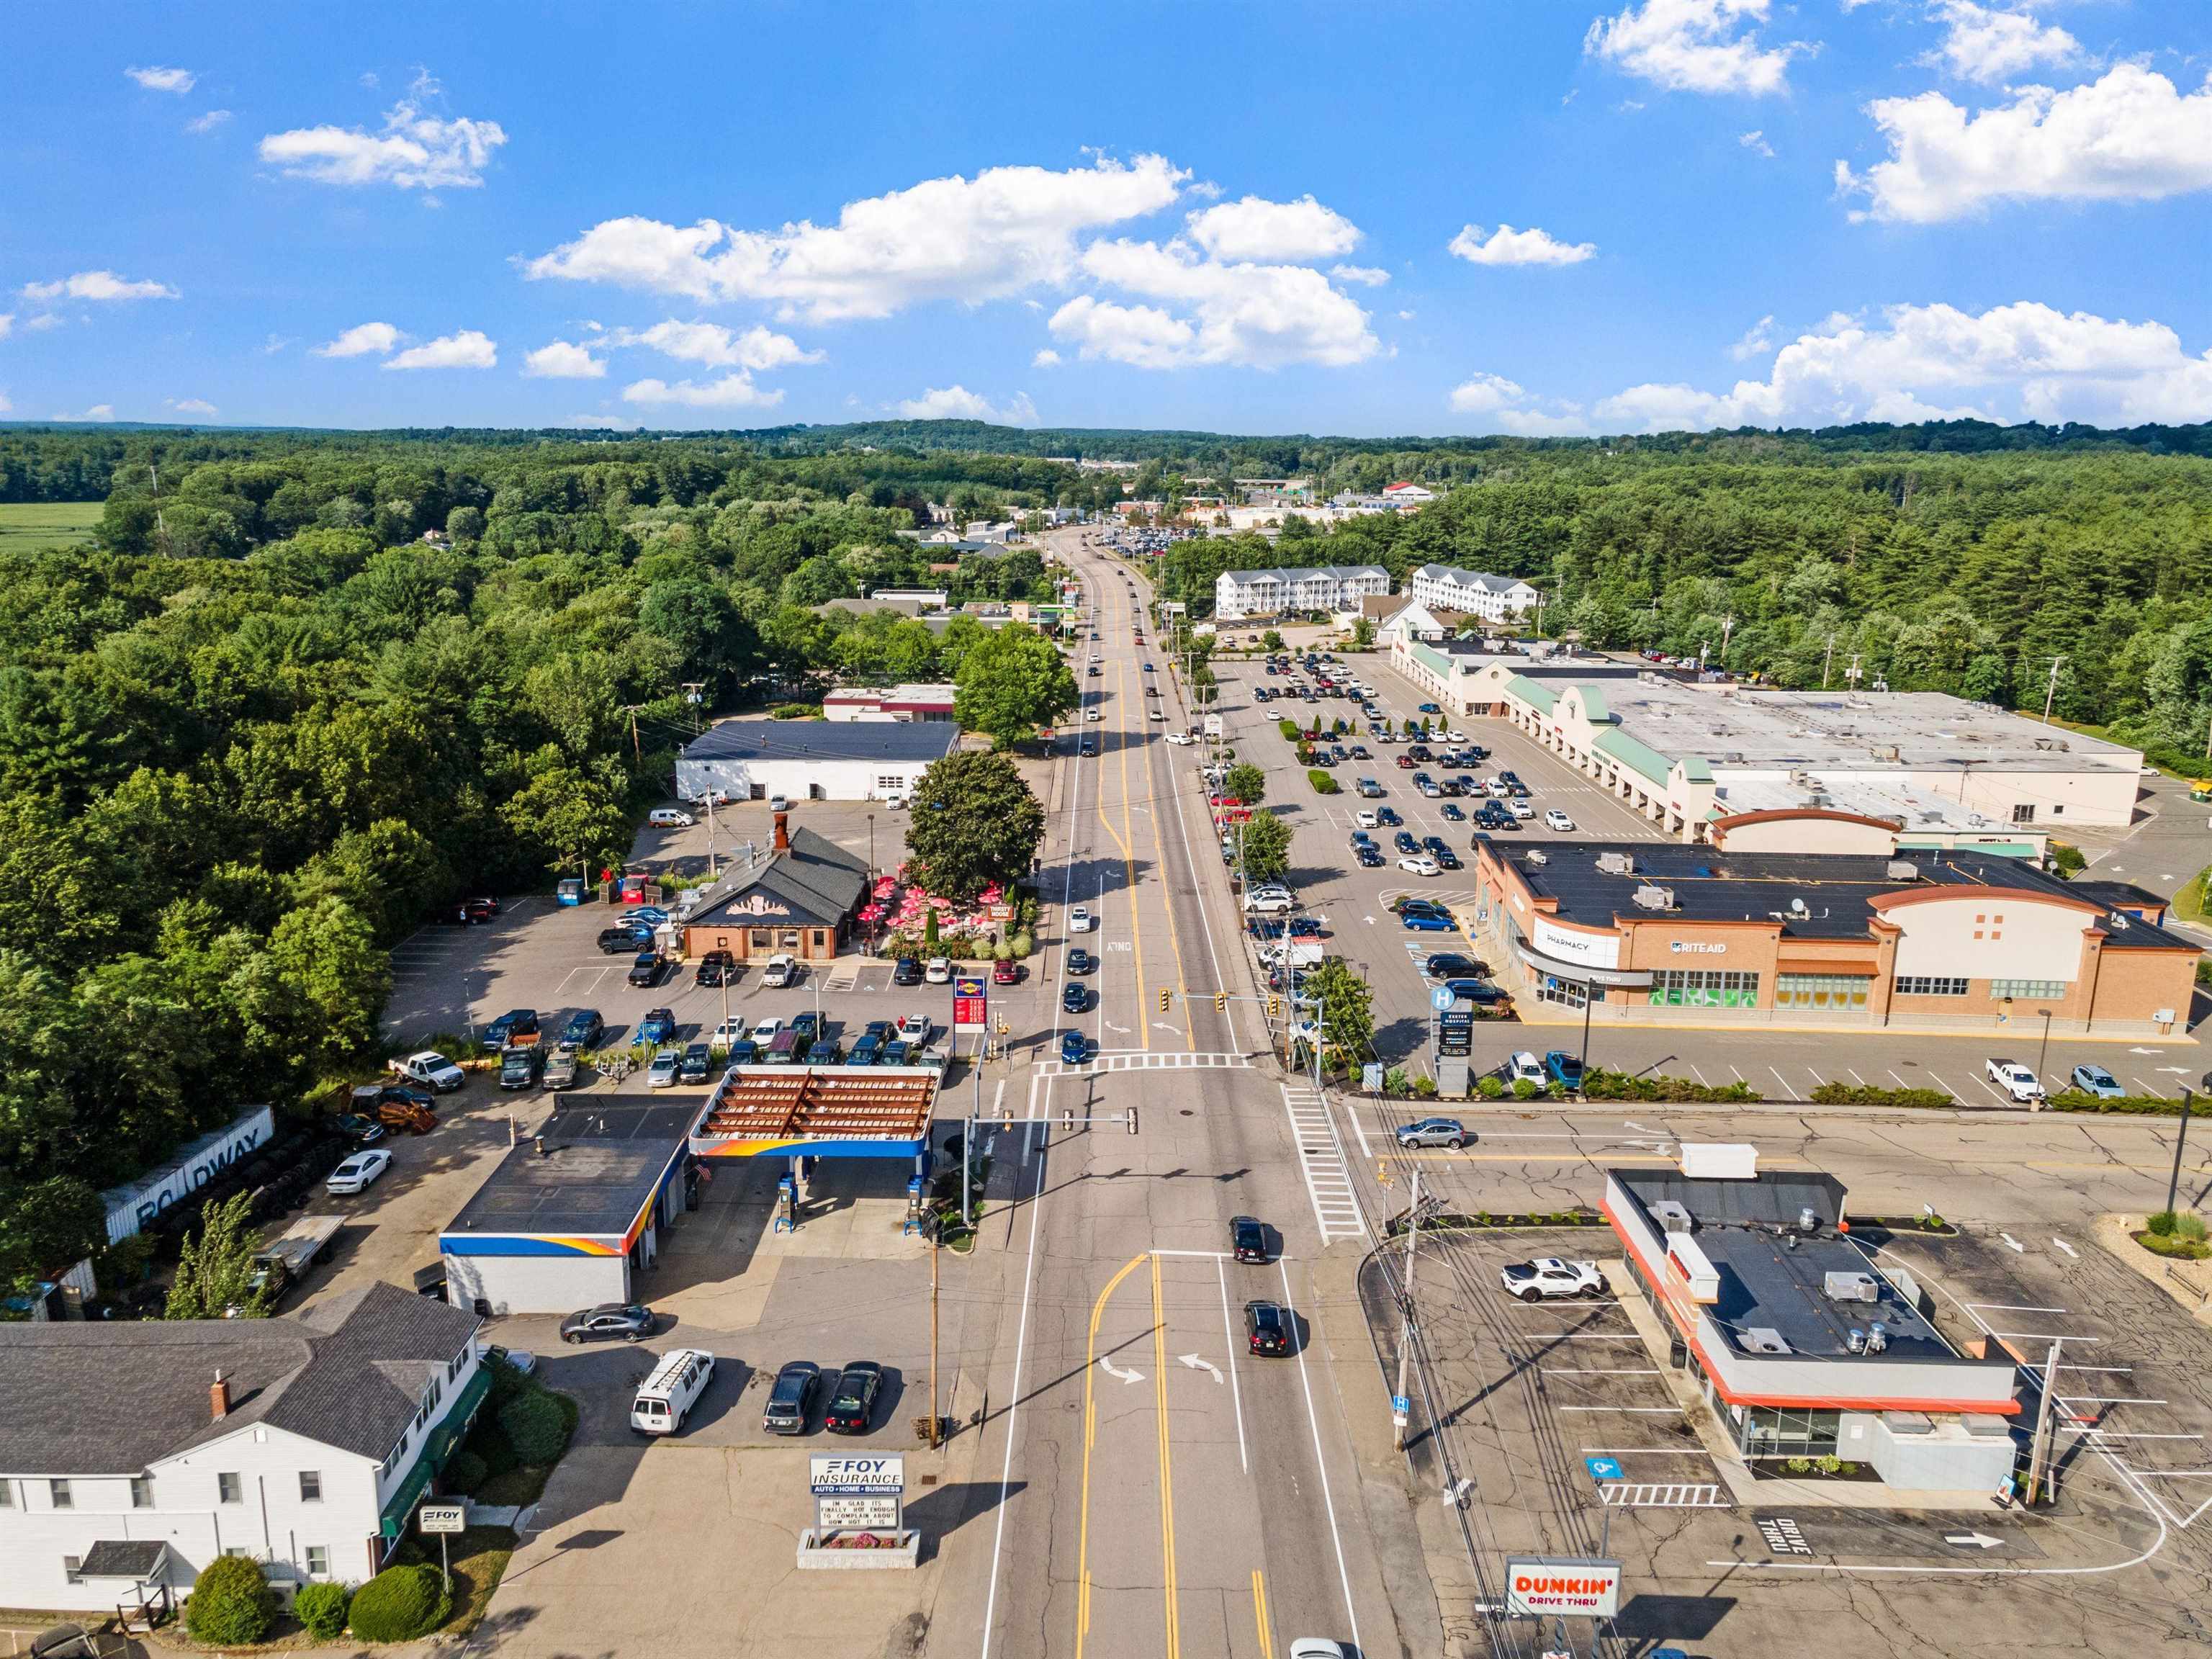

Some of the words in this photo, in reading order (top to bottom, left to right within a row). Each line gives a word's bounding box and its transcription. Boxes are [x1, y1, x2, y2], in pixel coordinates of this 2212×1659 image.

[1107, 941, 1132, 951] ONLY
[1547, 934, 1589, 950] PHARMACY
[1681, 943, 1707, 953] RITE
[1707, 944, 1727, 953] AID
[1436, 991, 1450, 1007] H
[1397, 1397, 1406, 1408] H
[843, 1460, 886, 1473] FOY
[814, 1475, 900, 1484] INSURANCE
[1758, 1519, 1791, 1552] THRU
[1776, 1518, 1813, 1554] DRIVE
[1528, 1596, 1563, 1606] DRIVE
[1566, 1598, 1598, 1606] THRU
